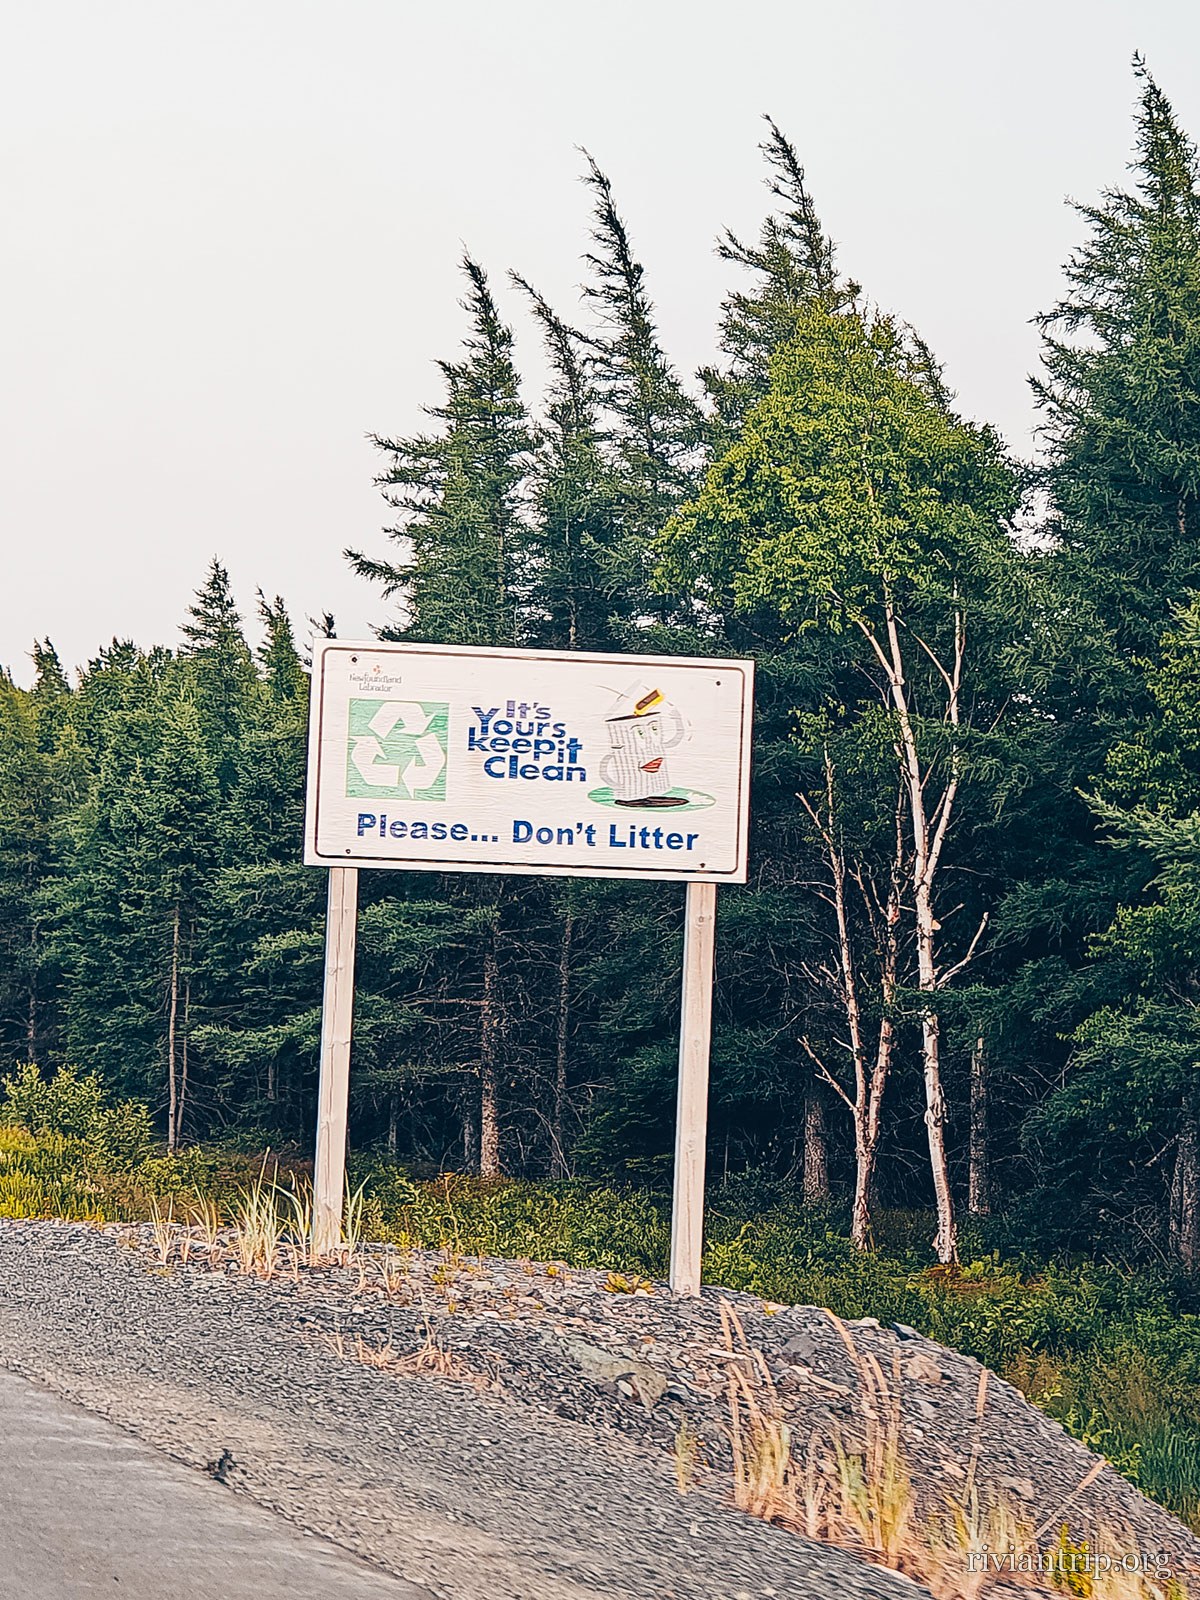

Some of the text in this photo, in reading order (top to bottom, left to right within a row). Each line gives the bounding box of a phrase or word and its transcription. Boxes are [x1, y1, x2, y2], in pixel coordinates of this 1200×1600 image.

[471, 706, 567, 738] Yours
[506, 700, 551, 720] It's
[483, 755, 587, 782] Clean
[357, 813, 700, 851] Please... Don't Litter
